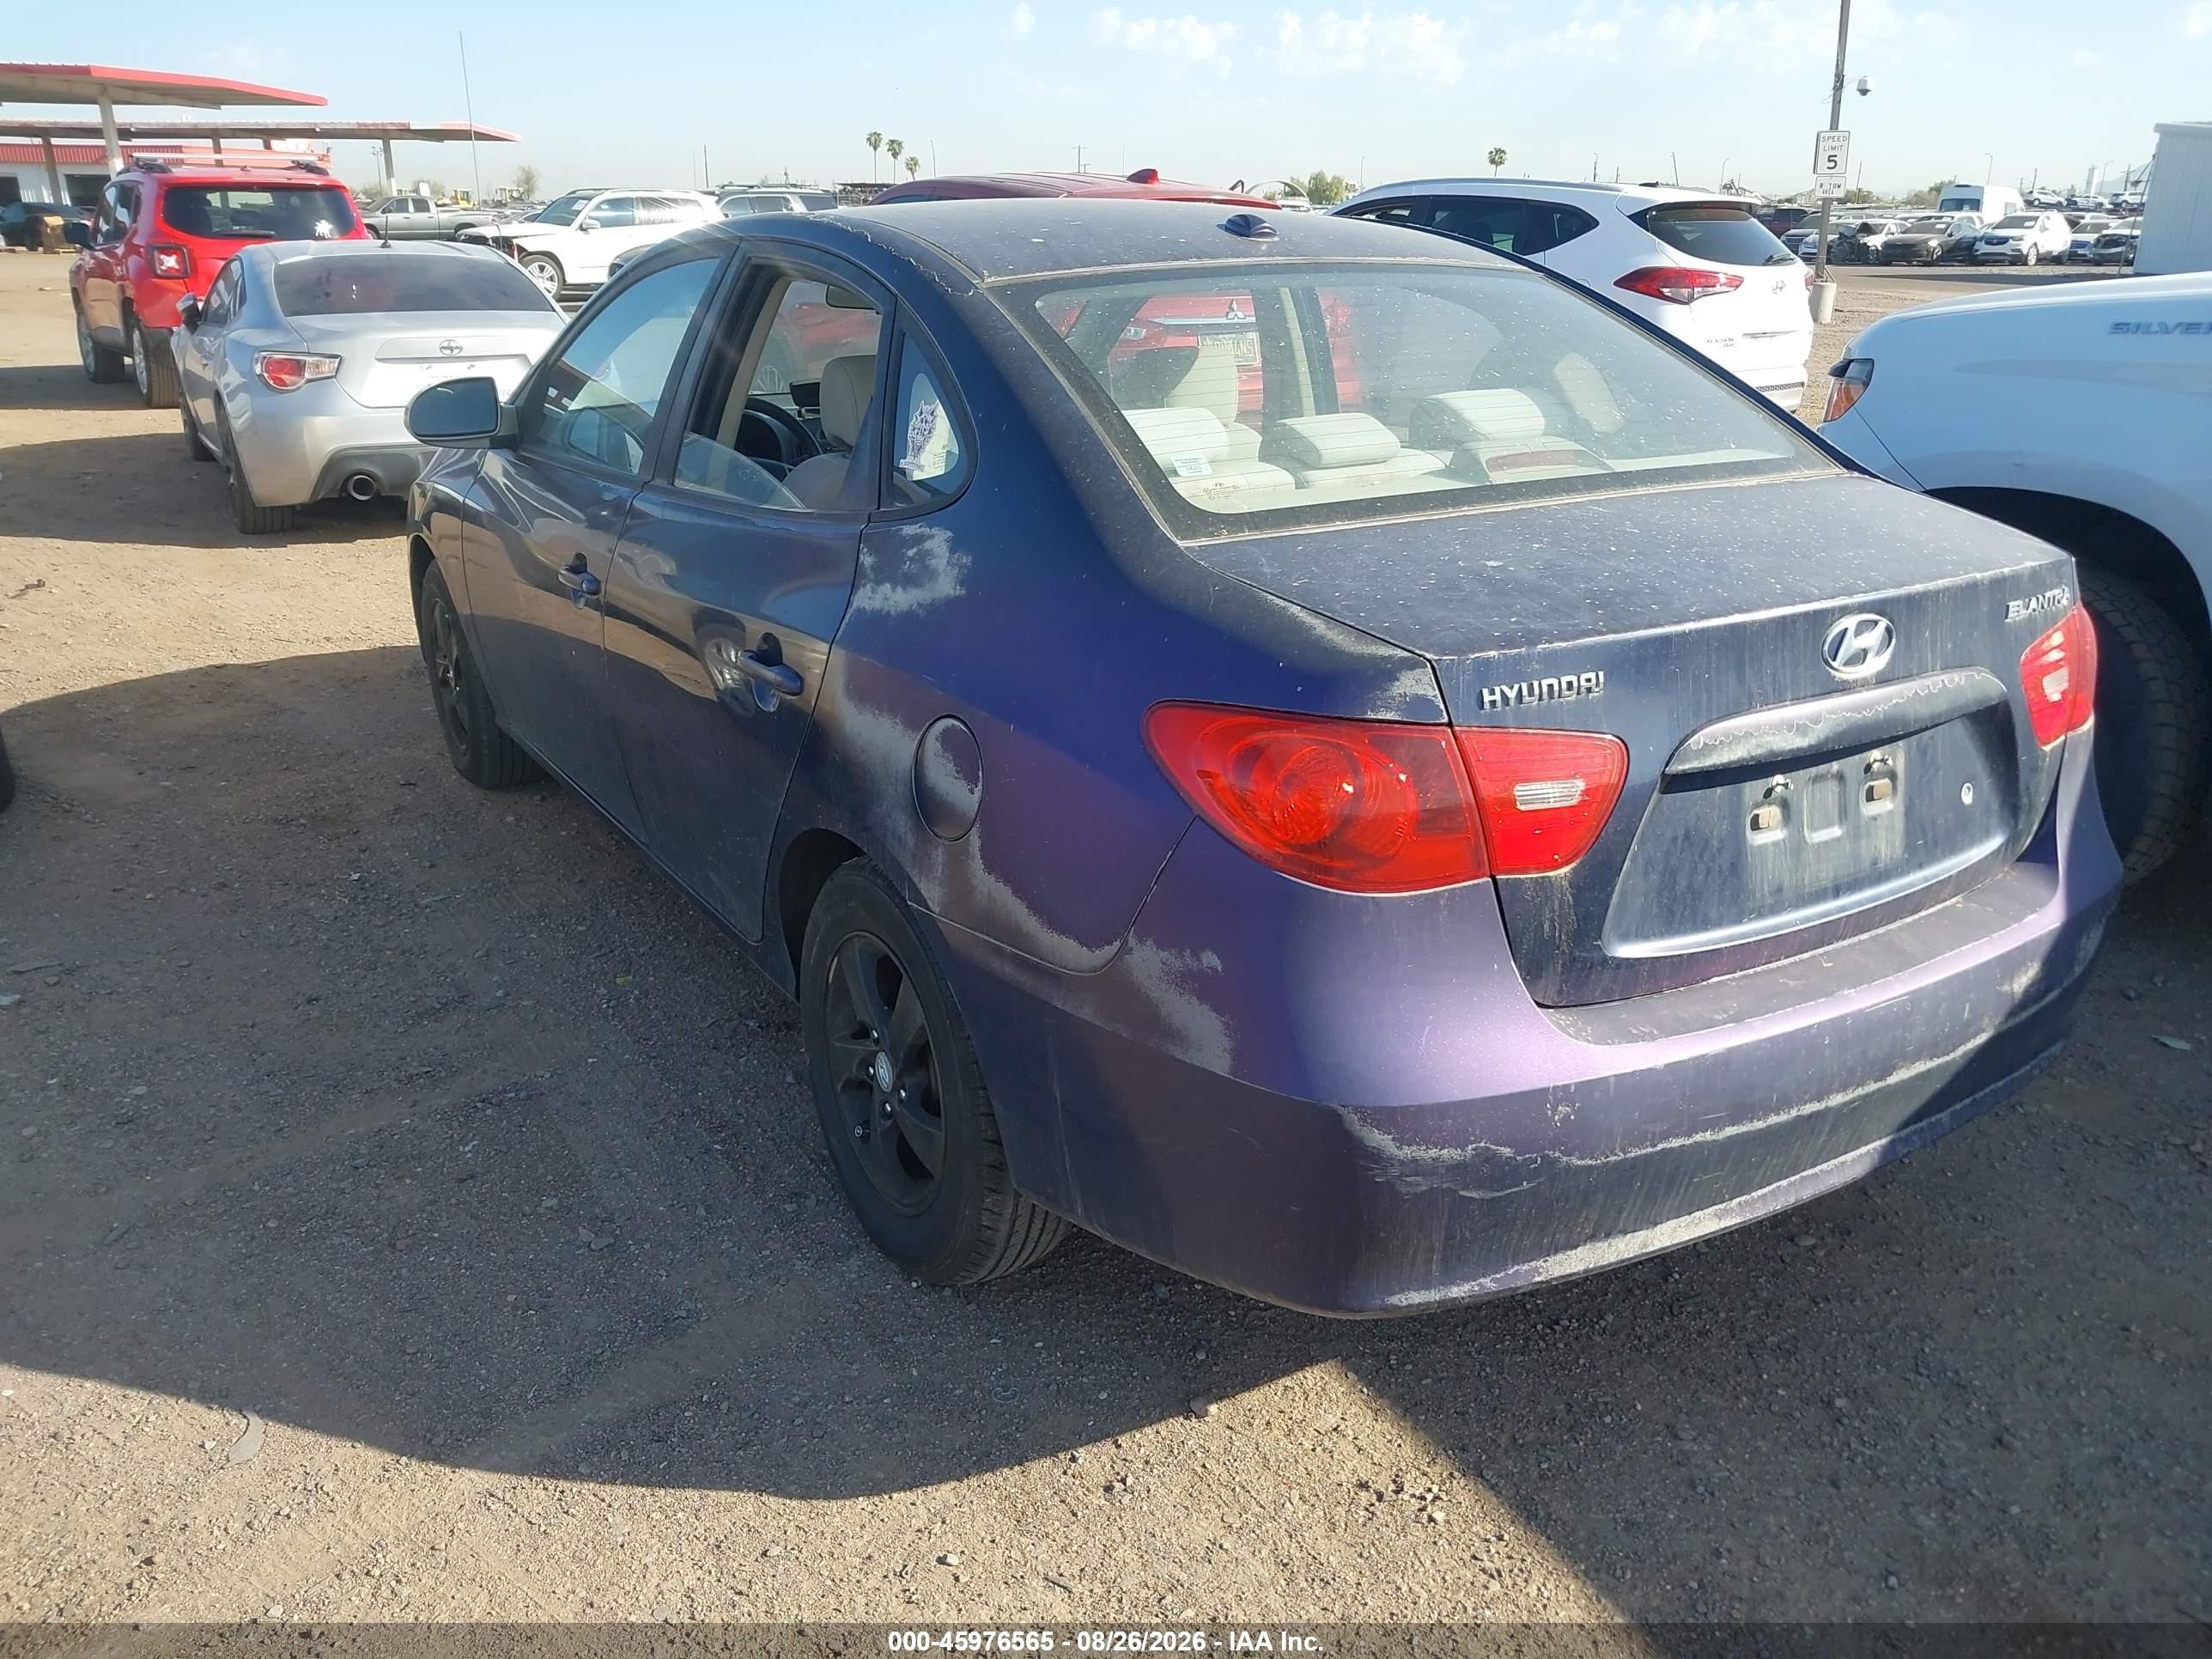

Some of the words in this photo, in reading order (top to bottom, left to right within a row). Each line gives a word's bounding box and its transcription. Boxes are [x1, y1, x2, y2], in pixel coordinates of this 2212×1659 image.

[1826, 154, 1838, 170] 5
[2004, 585, 2070, 622] ELANTRA
[1480, 671, 1605, 712] HYUNDAI
